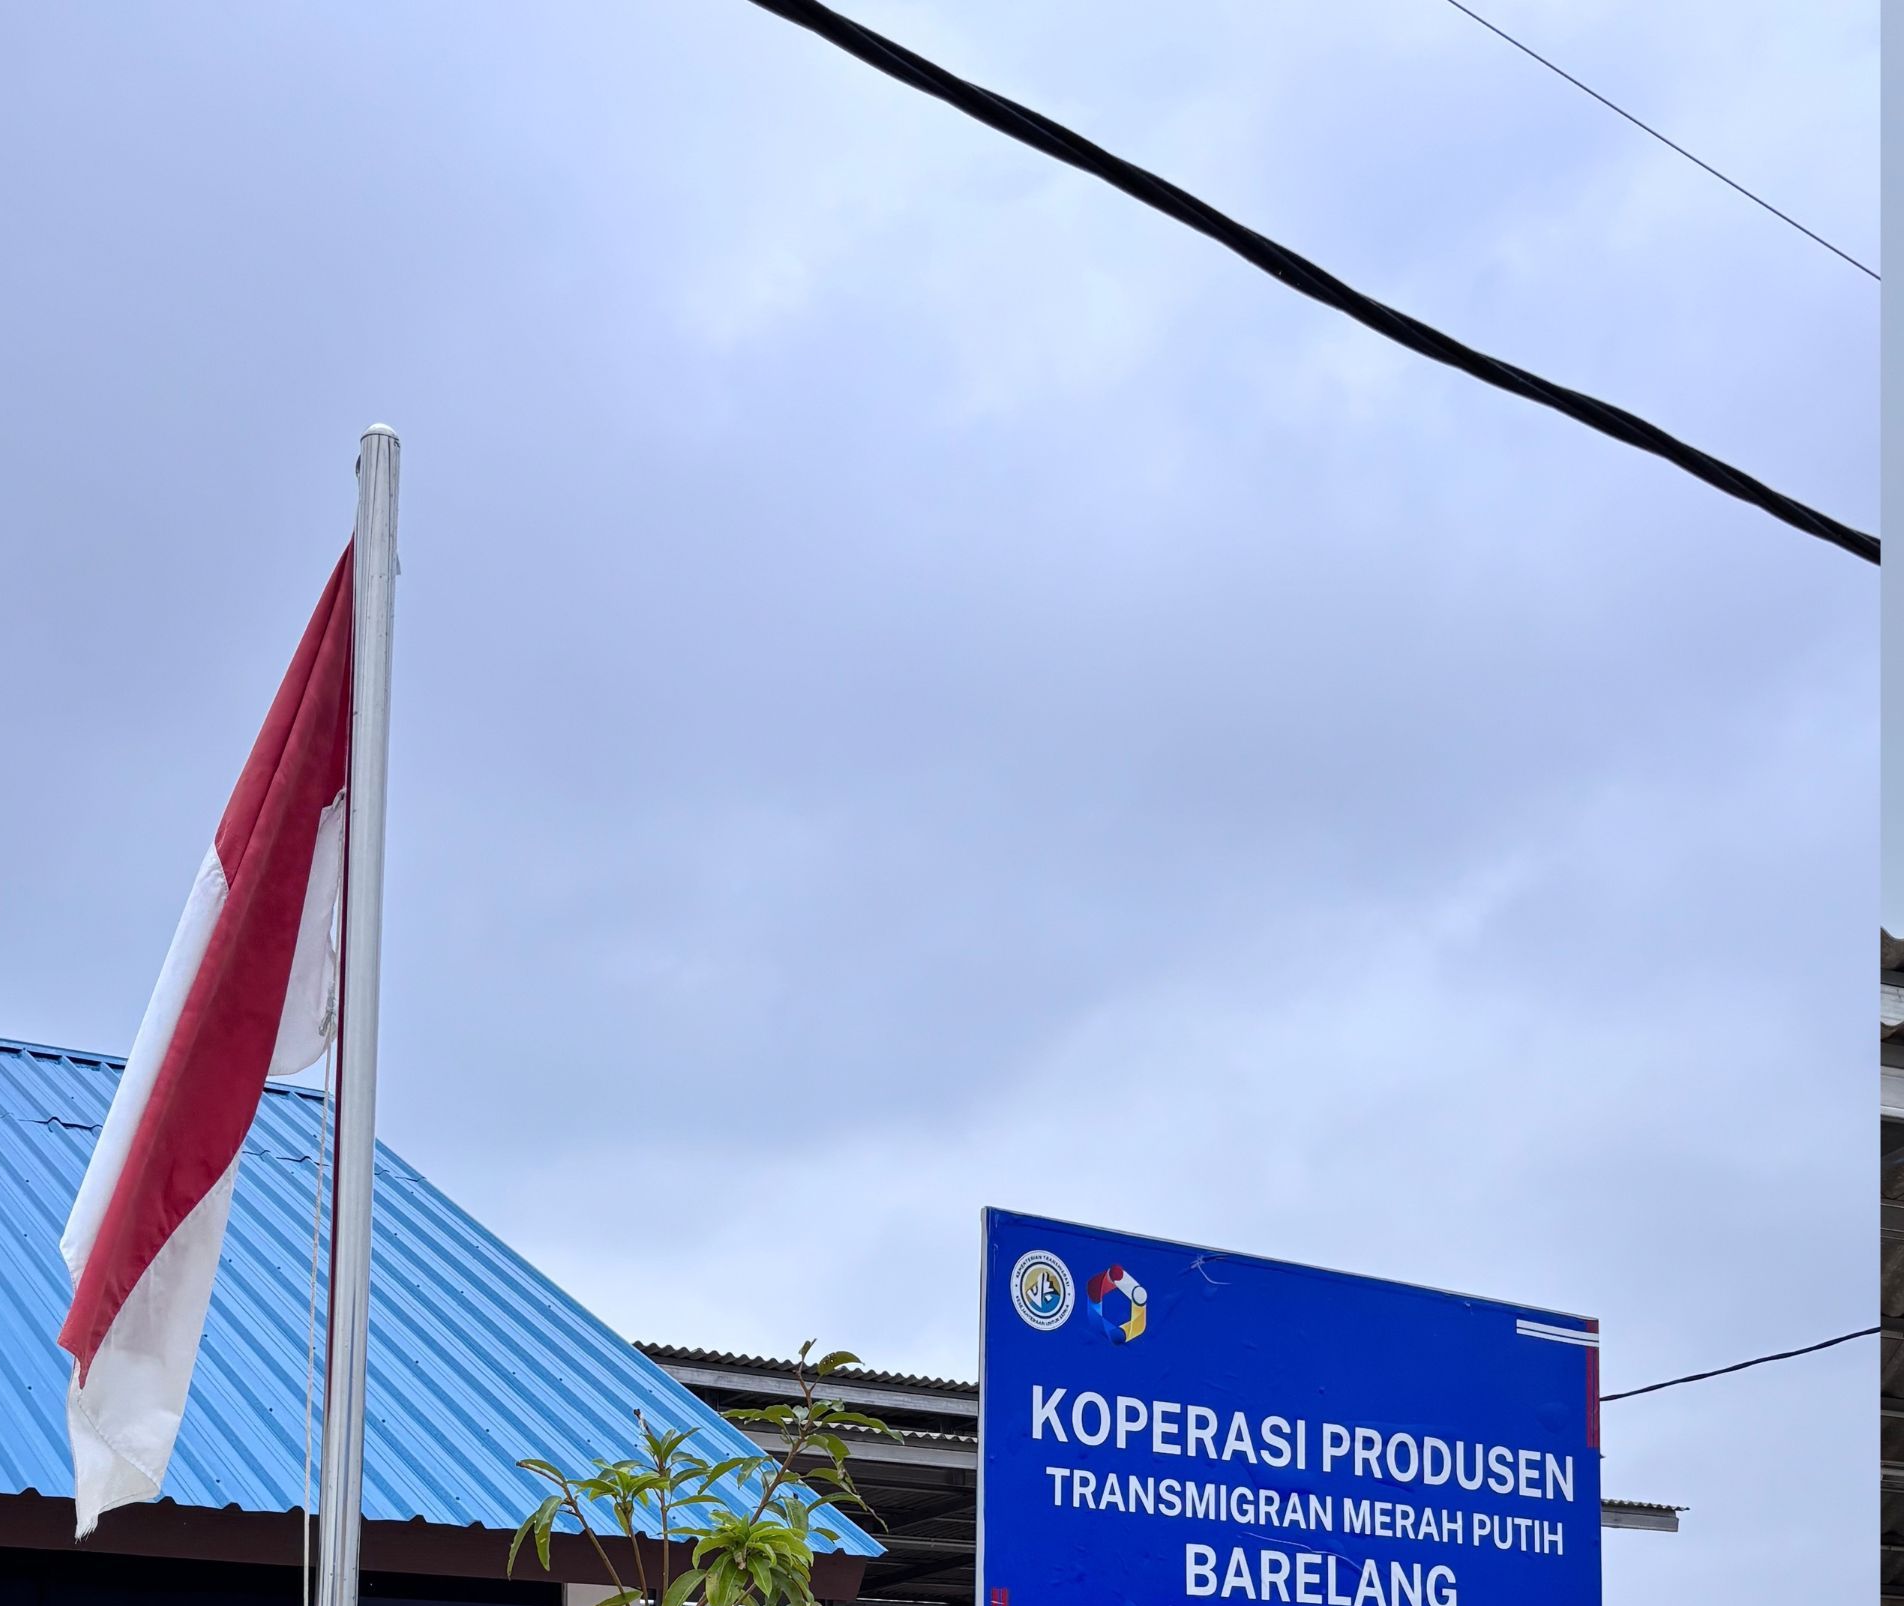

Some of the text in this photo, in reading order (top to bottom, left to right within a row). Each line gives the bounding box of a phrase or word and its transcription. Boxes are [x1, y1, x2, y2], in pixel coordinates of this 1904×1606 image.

[1031, 1384, 1574, 1503] KOPERASI PRODUSEN
[1045, 1466, 1564, 1556] TRANSMIGRAN MERAH PUTIH
